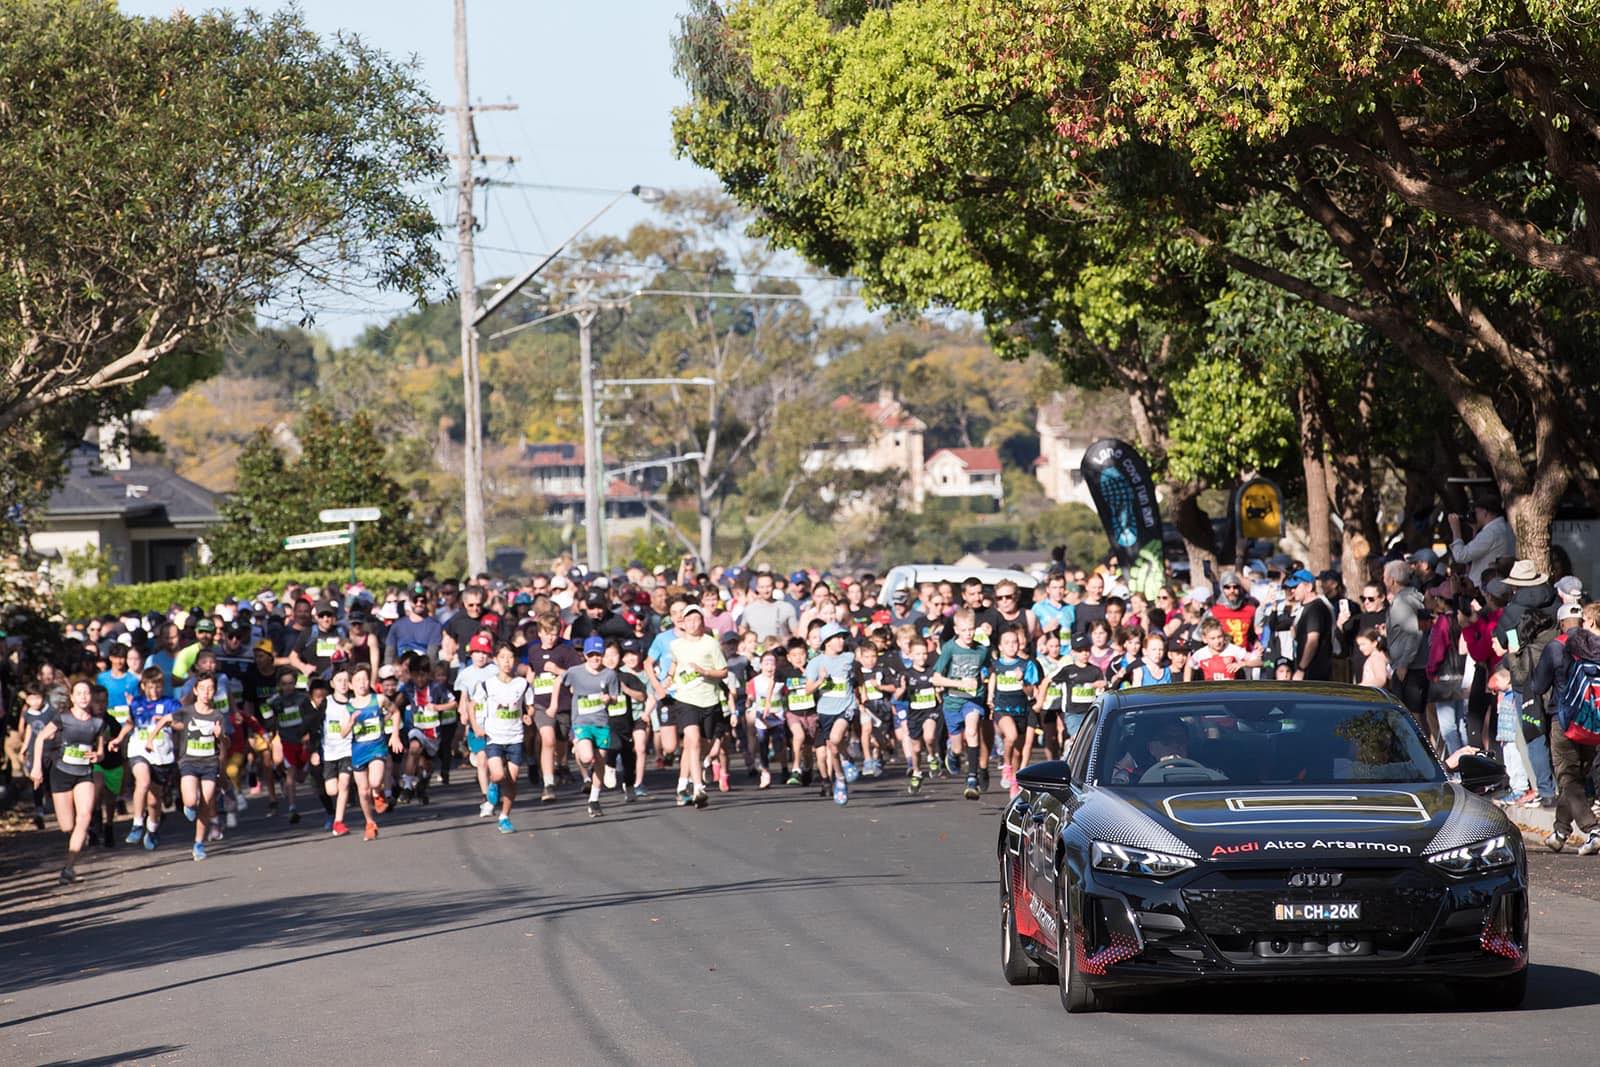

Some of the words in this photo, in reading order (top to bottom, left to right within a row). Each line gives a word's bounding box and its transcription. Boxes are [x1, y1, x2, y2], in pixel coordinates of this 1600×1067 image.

[1212, 840, 1260, 856] Audi
[1264, 840, 1306, 851] Alto
[1312, 839, 1413, 855] Artarmon
[1330, 904, 1360, 920] 26K
